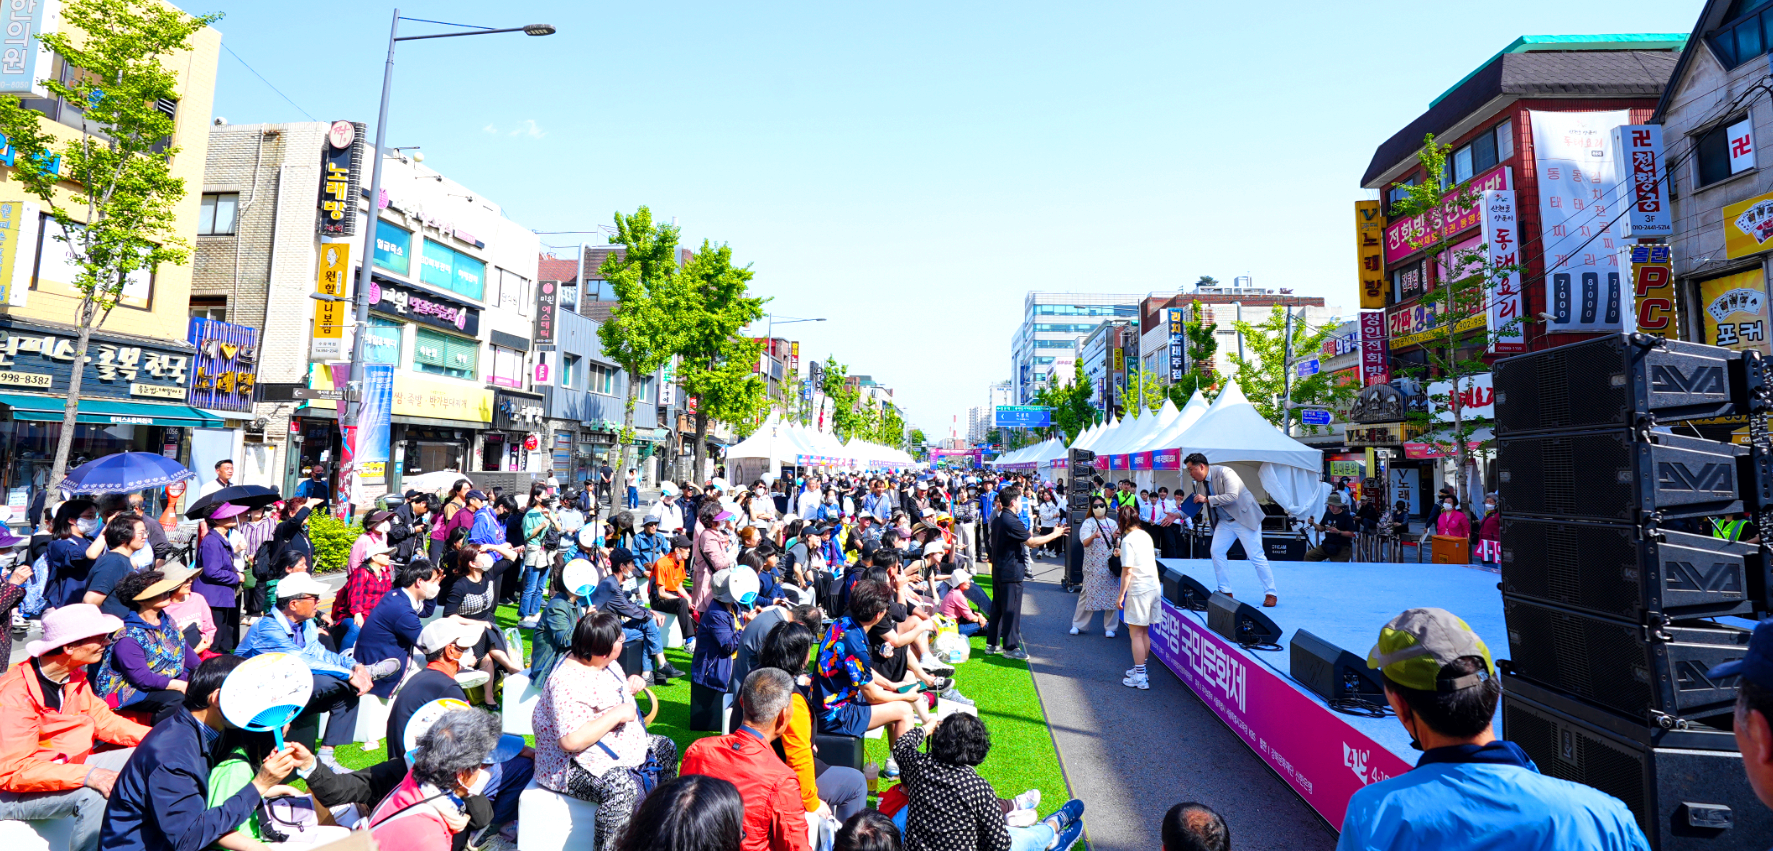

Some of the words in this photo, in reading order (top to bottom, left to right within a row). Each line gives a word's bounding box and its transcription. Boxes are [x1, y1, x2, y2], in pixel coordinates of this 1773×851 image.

[324, 162, 350, 221] 노래방
[1634, 152, 1660, 212] 천황궁
[1360, 209, 1377, 221] V
[1547, 167, 1568, 267] 동태찌개
[1645, 215, 1656, 223] 3F
[1362, 232, 1382, 298] 노래방
[1632, 246, 1669, 263] 홈런
[1494, 228, 1519, 319] 동태요리
[540, 295, 555, 305] 미원
[1636, 266, 1672, 330] PC
[540, 305, 552, 339] 에스테틱
[1717, 320, 1764, 347] 포커
[1361, 313, 1388, 379] 성인전화방
[1, 372, 51, 386] 998-8382
[144, 351, 188, 384] 천국
[1374, 375, 1391, 384] 7080
[1651, 365, 1725, 395] AVA
[165, 427, 179, 435] 1056
[1332, 462, 1357, 476] 임대문의
[1397, 468, 1408, 479] V
[1658, 461, 1733, 493] AVA
[1665, 561, 1742, 594] AVA
[1182, 622, 1247, 714] 국민문화제
